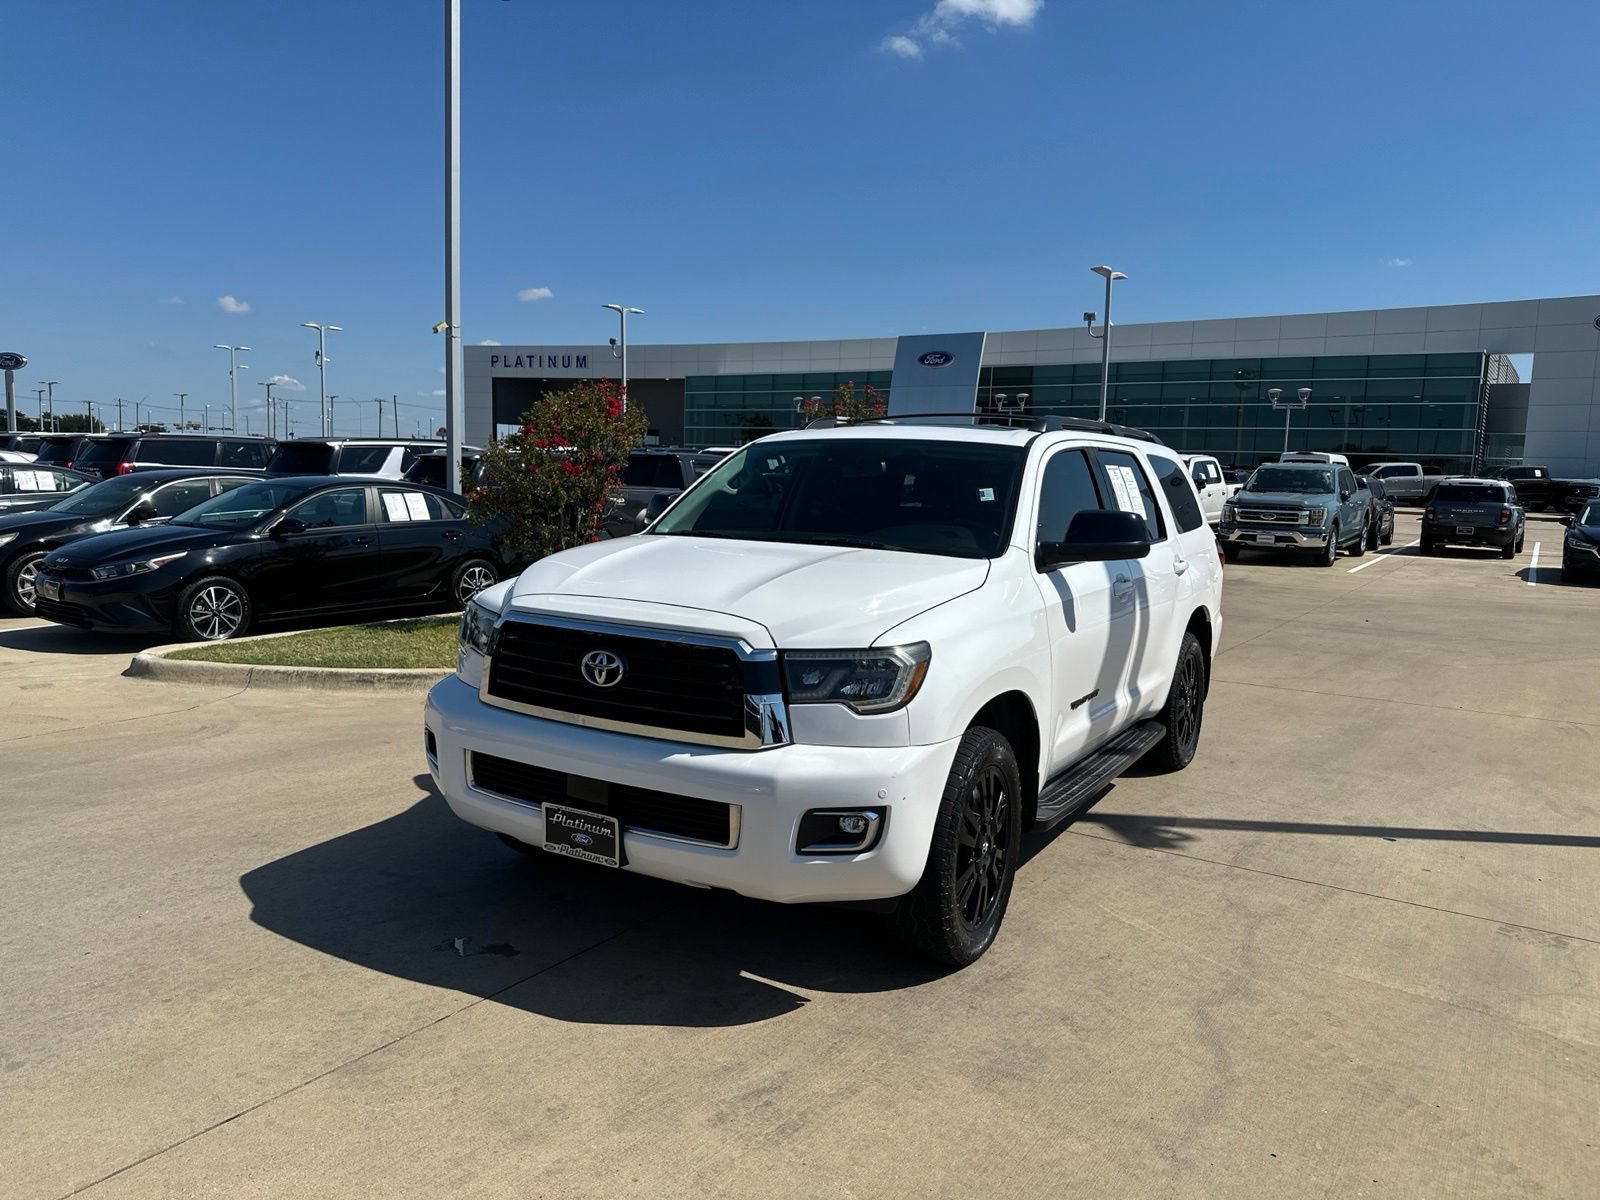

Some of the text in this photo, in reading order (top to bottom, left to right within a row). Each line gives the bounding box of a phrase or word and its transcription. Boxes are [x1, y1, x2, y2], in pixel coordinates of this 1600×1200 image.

[490, 354, 587, 369] PLATINUM
[924, 354, 946, 365] Ford
[549, 813, 615, 838] Platinum
[560, 845, 602, 863] Platinum
